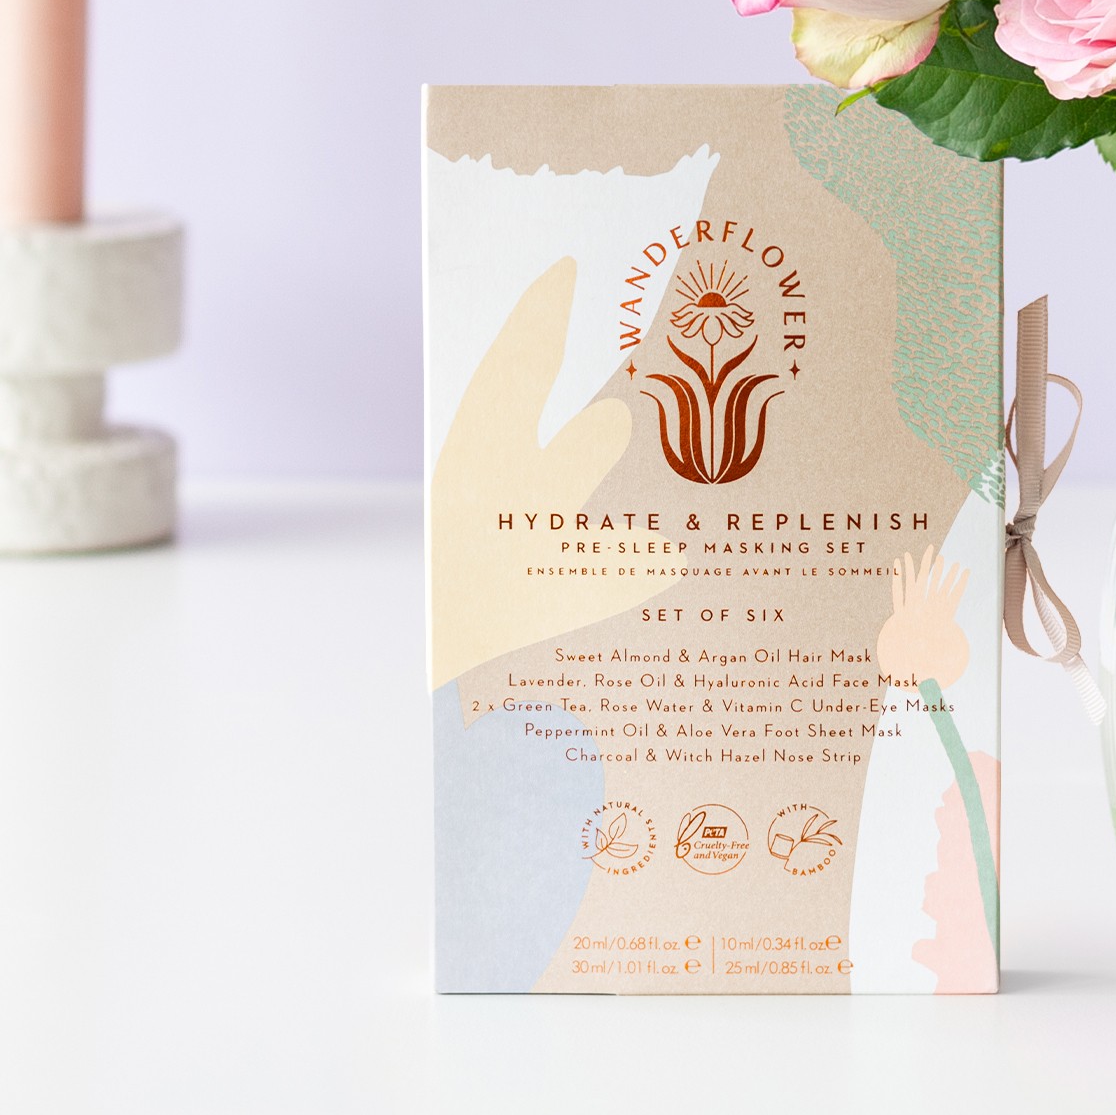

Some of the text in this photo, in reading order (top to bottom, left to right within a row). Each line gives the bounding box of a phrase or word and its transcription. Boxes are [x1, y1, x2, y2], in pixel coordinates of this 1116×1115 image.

[619, 219, 806, 351] WANDERFLOWER
[498, 512, 928, 531] HYDRATE & REPLENISH
[561, 541, 866, 554] PRE-SLEEP MASKING SET
[527, 566, 899, 577] ENSEMBLE DE MASQUAGE AVANT LE SOMMEIL
[641, 608, 784, 623] SET OF SIX
[555, 647, 872, 667] Sweet Almond & Argan Oil Hair Mask
[595, 673, 633, 688] Rose
[639, 673, 666, 688] Oil
[673, 673, 685, 688] &
[694, 673, 780, 692] Hyaluronic
[788, 673, 824, 688] Acid
[832, 673, 869, 688] Face
[877, 672, 918, 688] Mask
[472, 700, 480, 712] 2
[488, 703, 495, 712] x
[502, 697, 552, 712] Green
[600, 697, 638, 713] Rose
[645, 698, 694, 713] Water
[702, 698, 714, 713] &
[722, 699, 783, 713] Vitamin
[790, 698, 803, 713] C
[812, 698, 898, 715] Under-Eye
[906, 697, 955, 713] Masks
[525, 722, 902, 740] Peppermint Oil & Aloe Vera Foot Sheet Mask
[565, 747, 861, 766] Charcoal & Witch Hazel Nose Strip
[777, 804, 807, 818] WITH
[582, 801, 643, 850] WITH NATURAL
[607, 818, 657, 876] INGREDIENTS
[694, 841, 749, 851] Cruelty-Free
[712, 852, 739, 861] Vegan
[792, 849, 836, 876] BAMBOO
